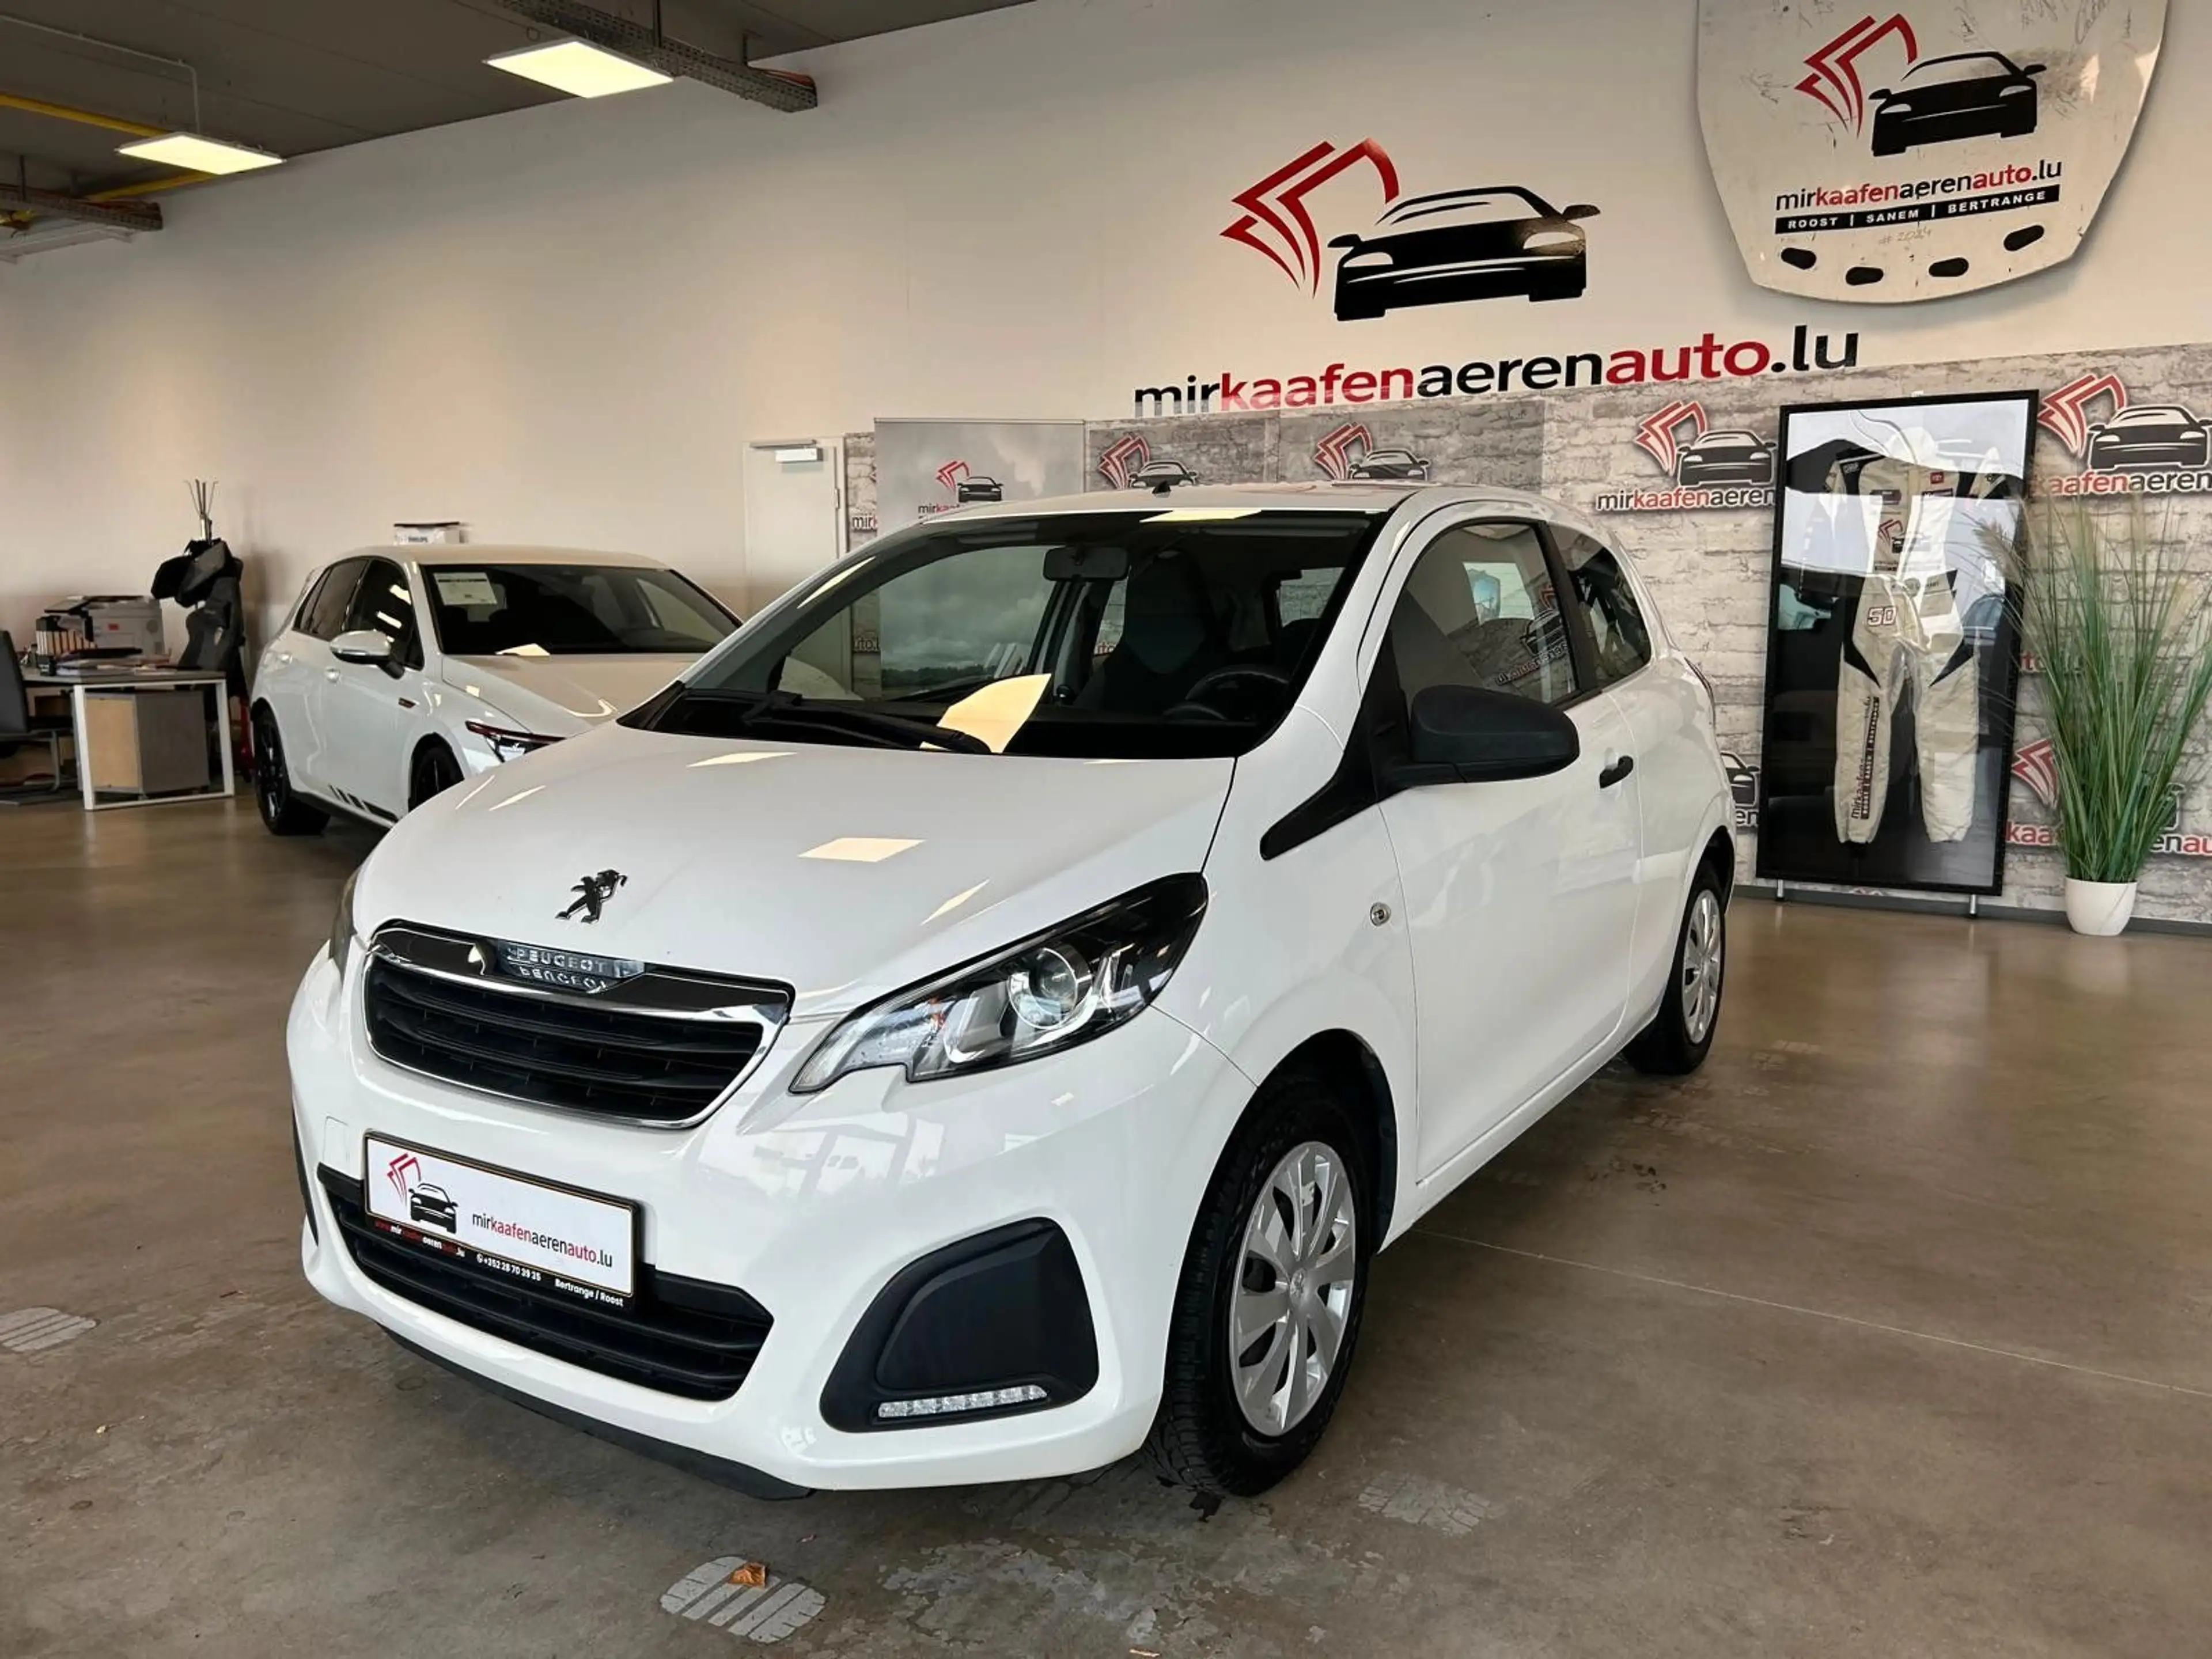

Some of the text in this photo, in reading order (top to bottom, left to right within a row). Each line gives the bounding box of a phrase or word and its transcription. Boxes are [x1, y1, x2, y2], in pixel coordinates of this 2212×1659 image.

[1776, 160, 2062, 210] mirkaafenaerenauto.lu
[1788, 216, 1838, 229] ROOST
[1866, 209, 1919, 224] SANEM
[1948, 190, 2046, 214] BERTRANGE
[1135, 325, 1858, 416] mirkaafenaerenauto.lu
[517, 949, 605, 973] PEUGEOT
[472, 1213, 612, 1268] mirkaafenaerenauto.lu
[512, 1265, 520, 1275] 70
[555, 1278, 594, 1300] Bertrange
[600, 1293, 623, 1307] Roost
